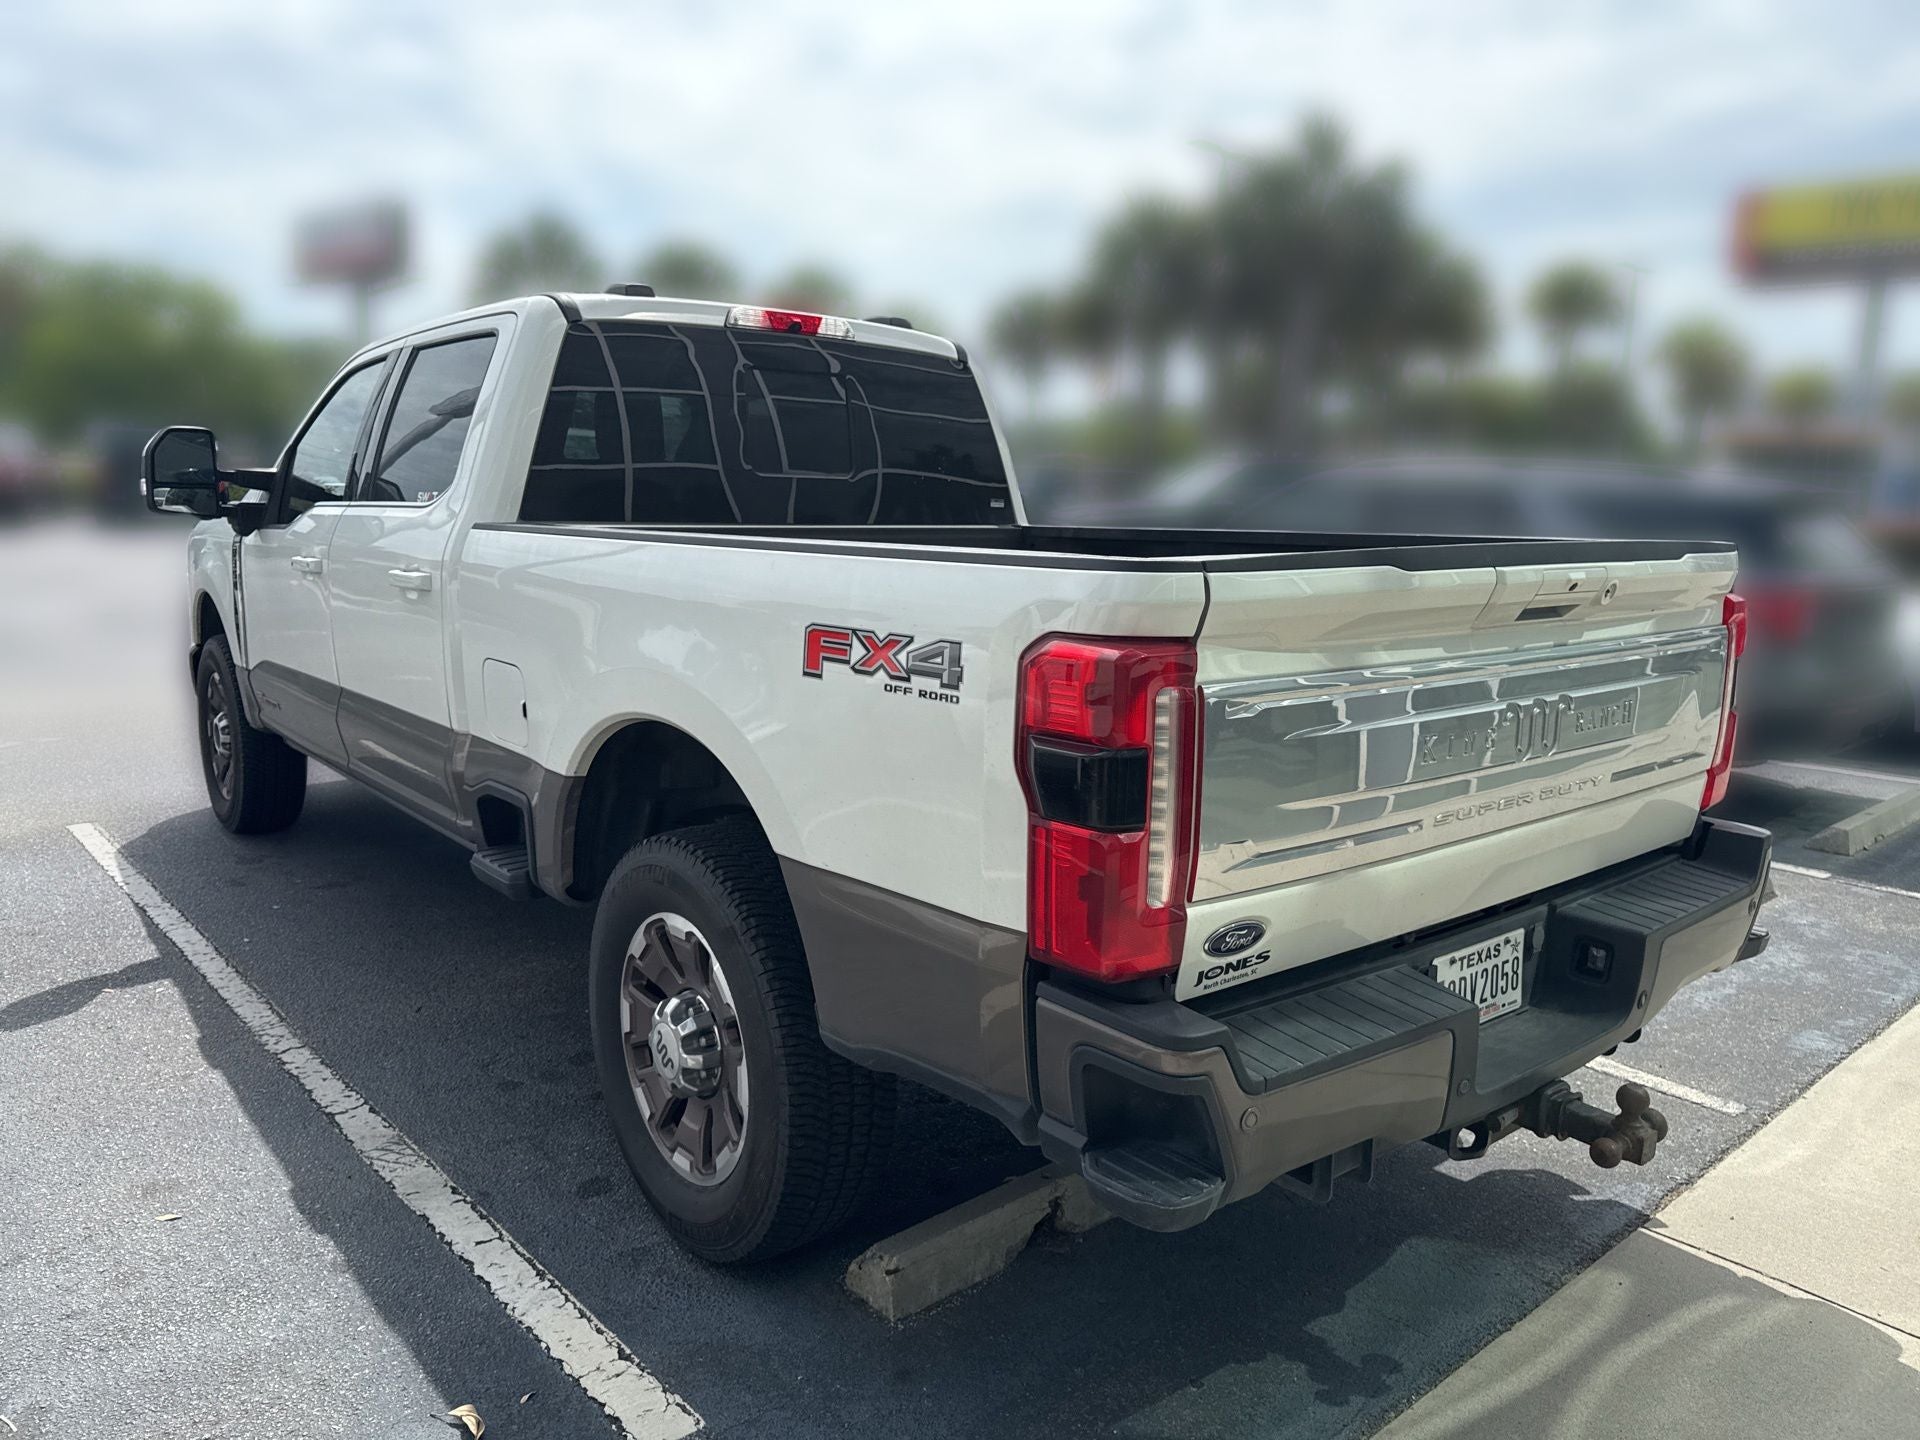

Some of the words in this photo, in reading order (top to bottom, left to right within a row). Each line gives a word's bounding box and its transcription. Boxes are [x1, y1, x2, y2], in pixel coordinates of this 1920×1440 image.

[802, 622, 964, 691] FX4
[884, 683, 913, 696] OFF
[918, 689, 960, 705] ROAD
[1421, 726, 1498, 765] KING
[1575, 700, 1634, 733] RANCH
[1433, 791, 1534, 828] SUPER
[1539, 775, 1604, 801] DUTY
[1220, 929, 1256, 952] Ford
[1193, 950, 1271, 988] JONES
[1458, 943, 1502, 972] TEXAS
[1203, 980, 1219, 990] North
[1250, 967, 1259, 976] SC
